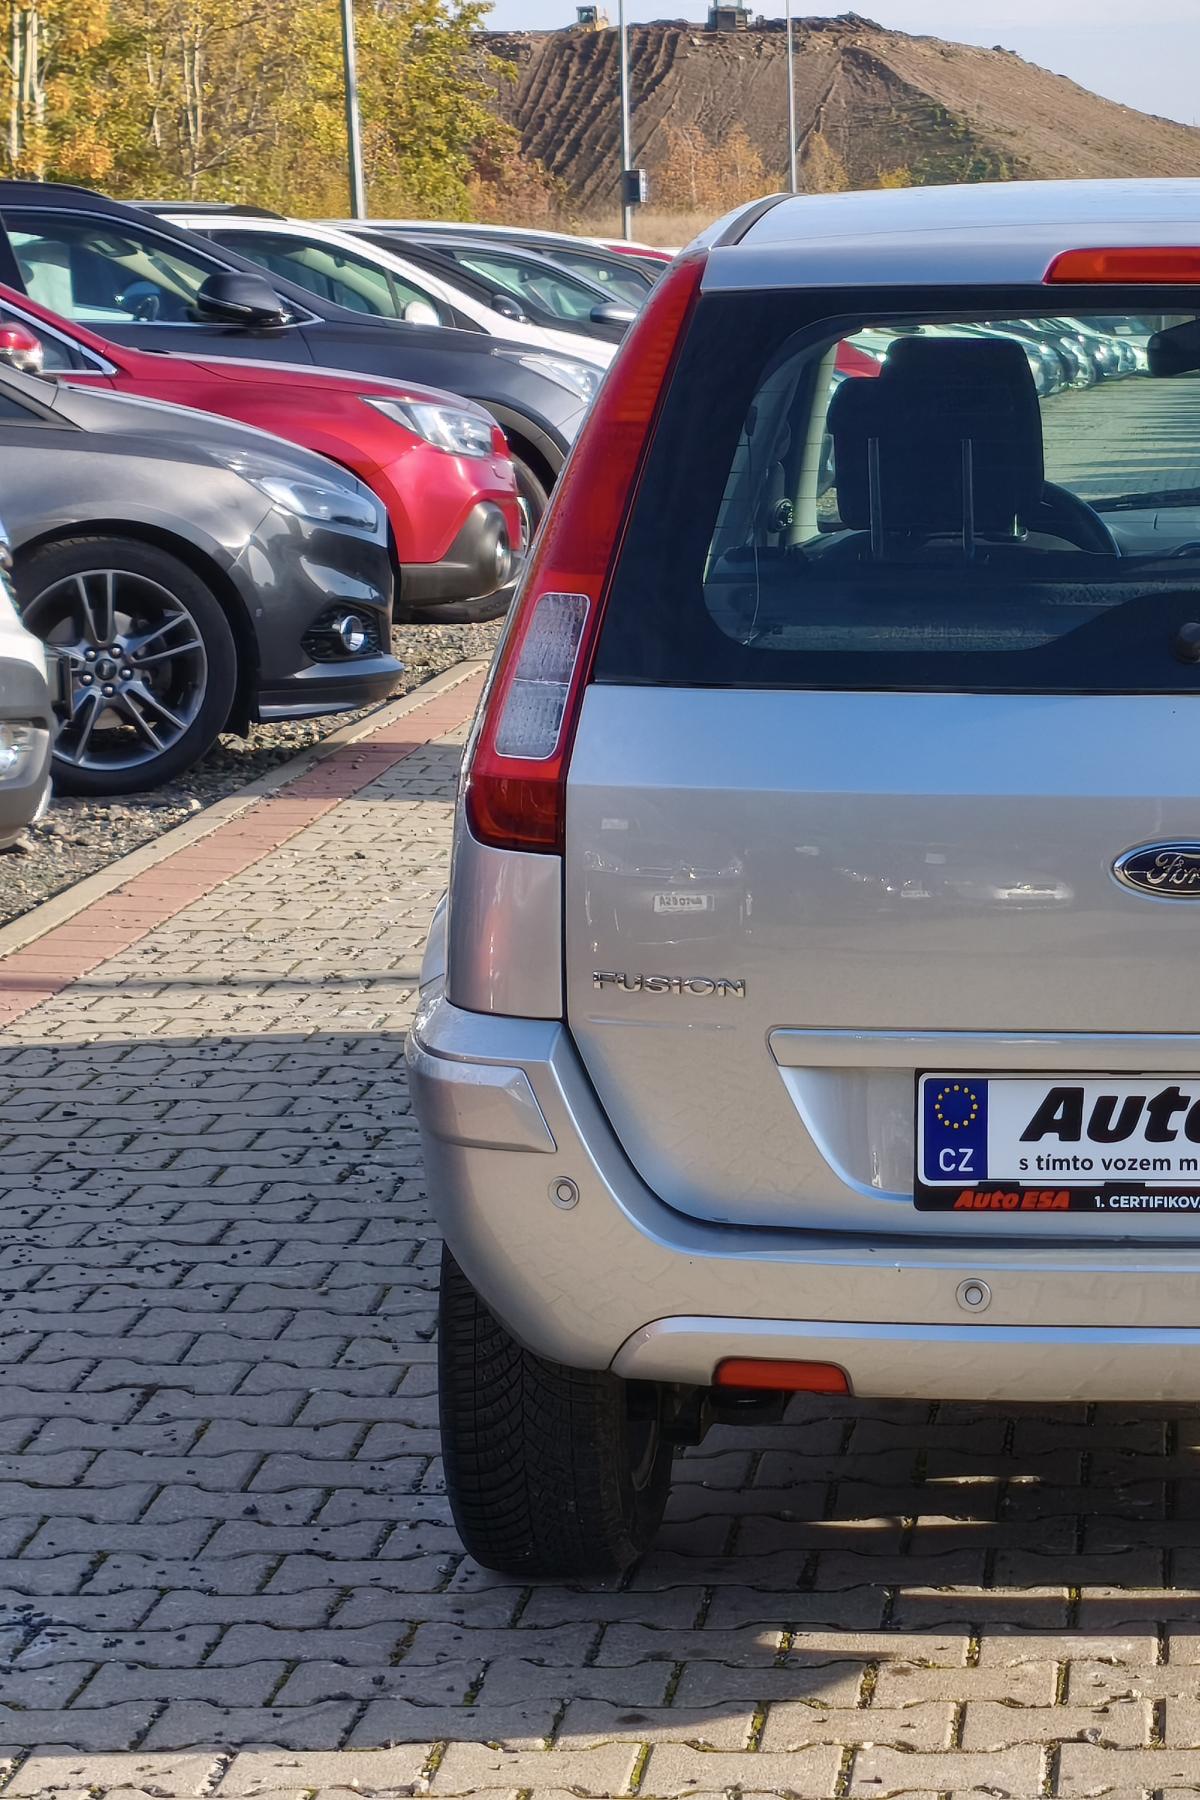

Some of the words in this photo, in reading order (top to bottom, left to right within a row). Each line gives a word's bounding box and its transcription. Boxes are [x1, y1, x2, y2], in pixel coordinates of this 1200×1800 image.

[592, 970, 746, 998] FUSION
[938, 1147, 974, 1172] CZ
[1019, 1157, 1029, 1171] s
[1035, 1154, 1094, 1171] tímto
[1101, 1157, 1171, 1171] vozem
[954, 1190, 1019, 1209] Auto
[1020, 1191, 1071, 1209] ESA
[1094, 1196, 1105, 1208] 1.
